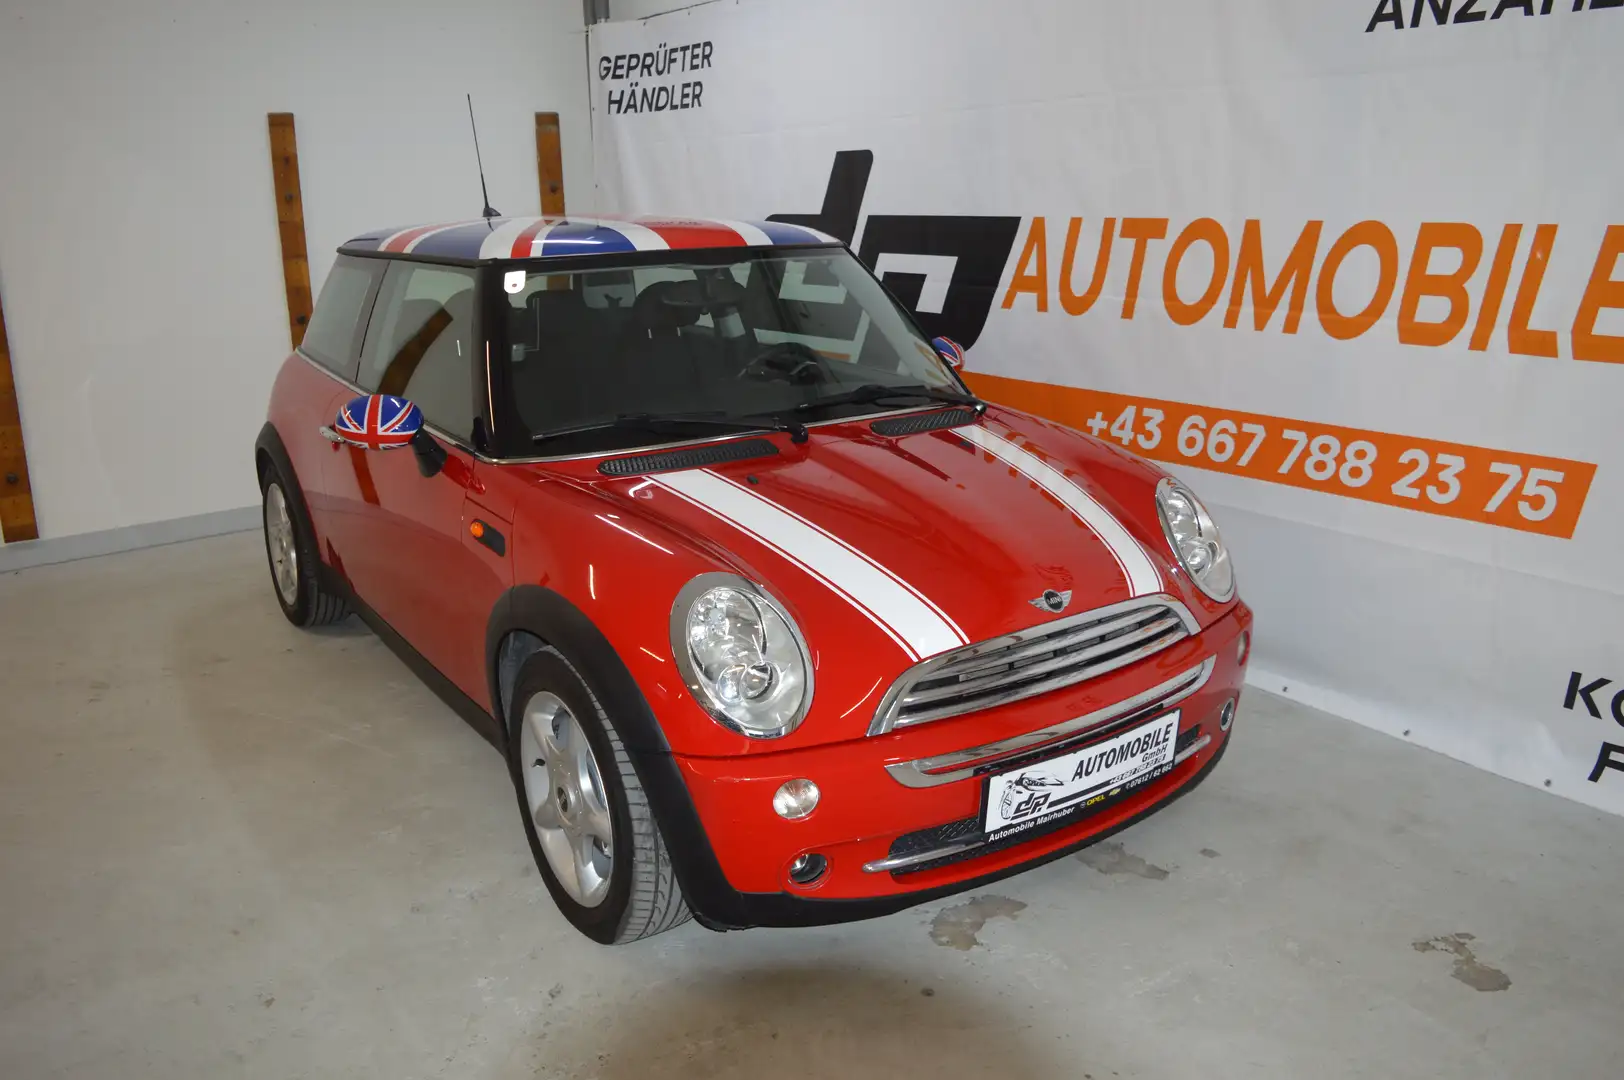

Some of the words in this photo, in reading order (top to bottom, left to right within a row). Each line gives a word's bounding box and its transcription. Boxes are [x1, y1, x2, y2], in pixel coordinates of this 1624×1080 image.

[599, 41, 713, 80] GEPRÜFTER
[608, 81, 703, 114] HÄNDLER
[1086, 405, 1163, 450] +43
[1177, 415, 1266, 463] 667
[1277, 429, 1377, 487] 788
[1391, 448, 1466, 504] 23
[1483, 462, 1564, 521] 75
[1071, 722, 1173, 782] AUTOMOBILE
[1142, 744, 1168, 762] GmbH
[1086, 795, 1105, 806] OPEL
[989, 821, 1035, 842] Automobile
[1037, 807, 1075, 826] Mairhuber
